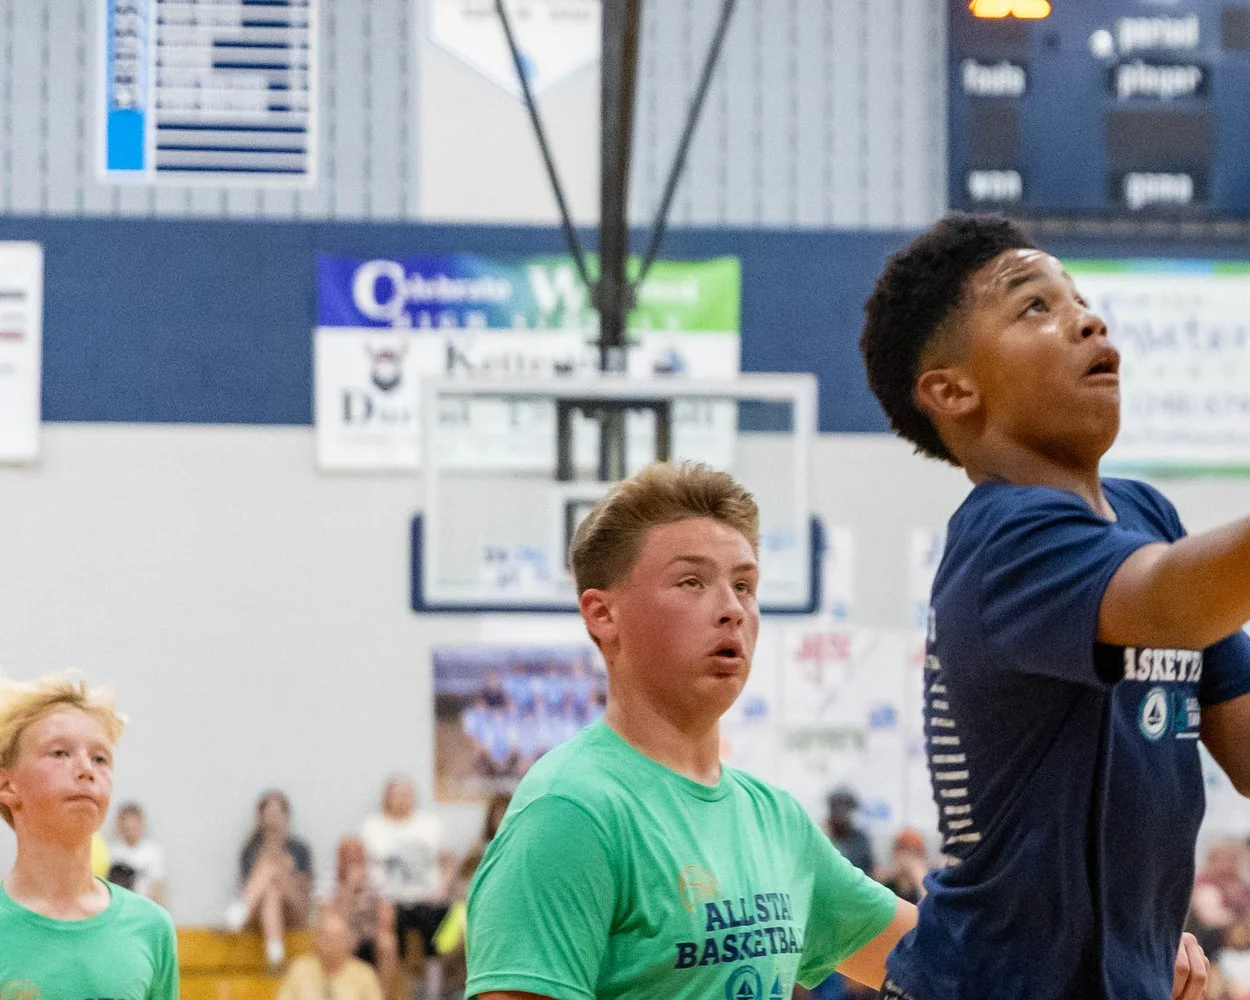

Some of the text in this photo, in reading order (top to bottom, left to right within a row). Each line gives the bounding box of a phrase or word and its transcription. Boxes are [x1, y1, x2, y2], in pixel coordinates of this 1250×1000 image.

[705, 892, 795, 932] ALL STA
[674, 926, 804, 970] BASKETBA
